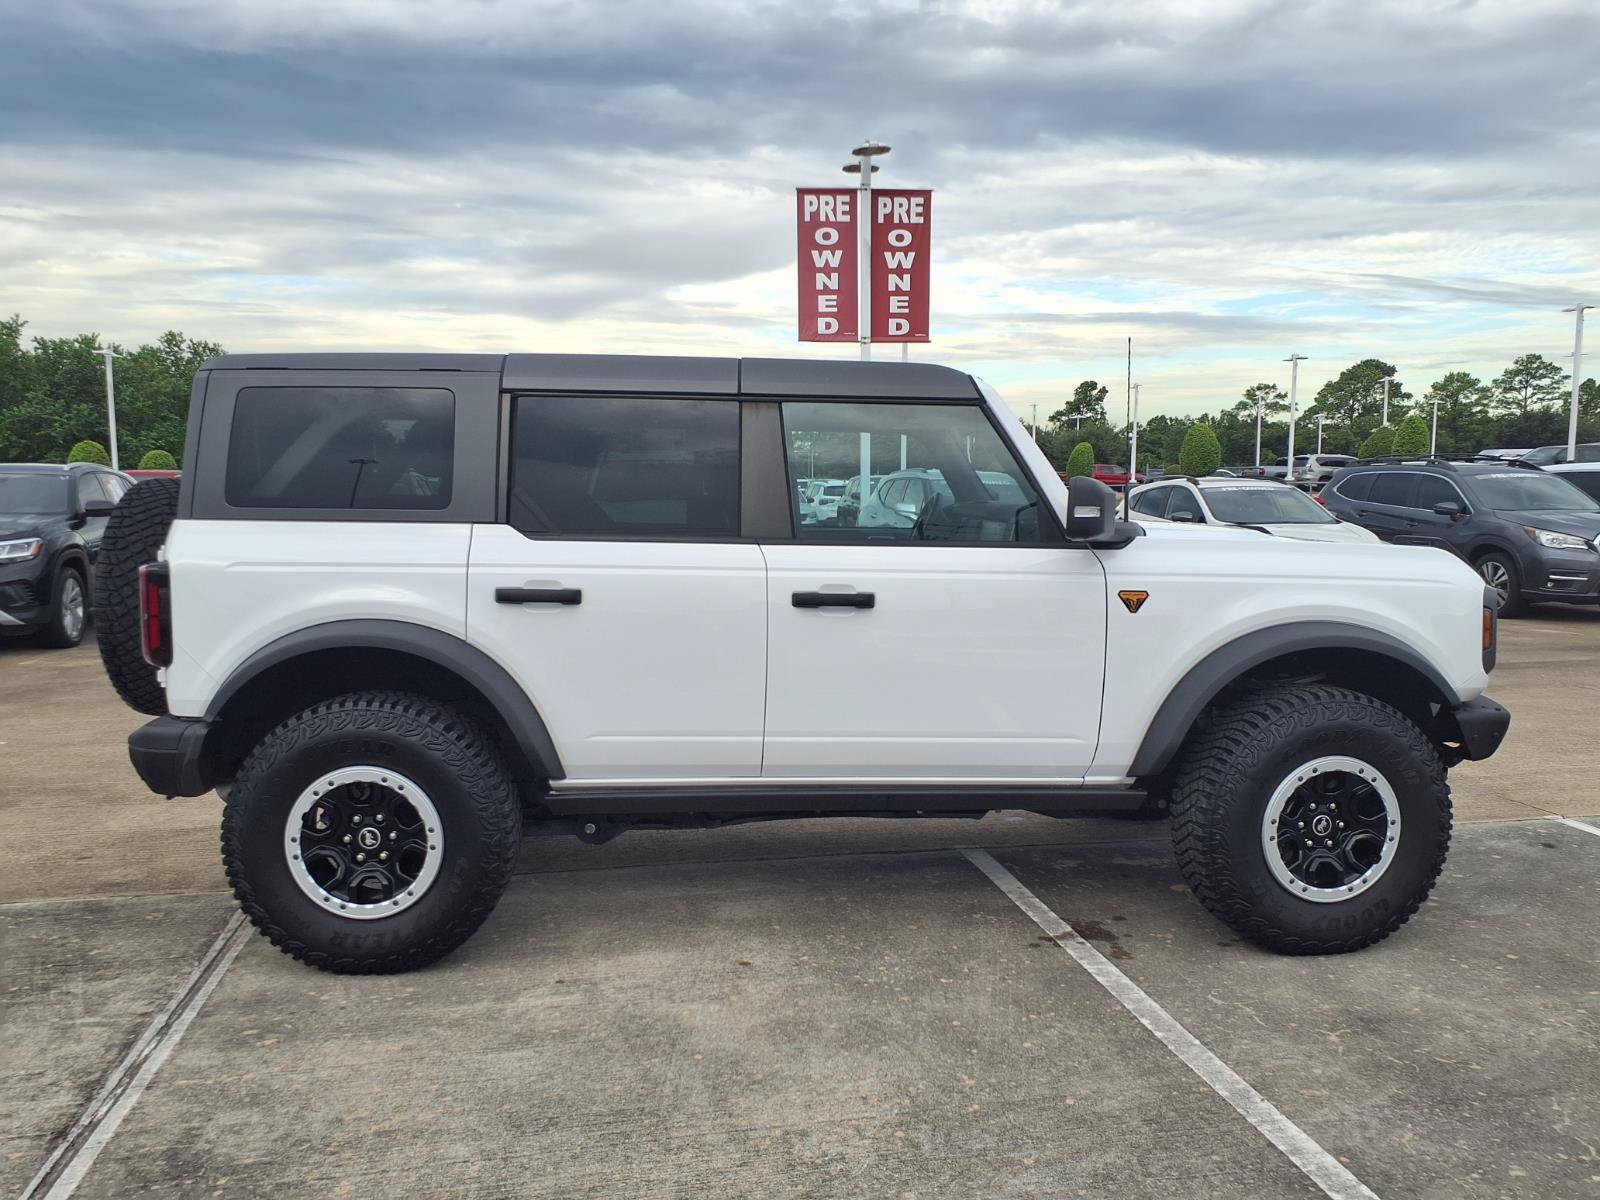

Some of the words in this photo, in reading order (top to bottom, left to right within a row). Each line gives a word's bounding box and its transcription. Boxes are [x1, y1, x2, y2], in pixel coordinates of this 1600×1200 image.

[804, 194, 851, 222] PRE
[877, 196, 925, 224] PRE
[811, 227, 843, 335] OWNED
[883, 229, 916, 336] OWNED
